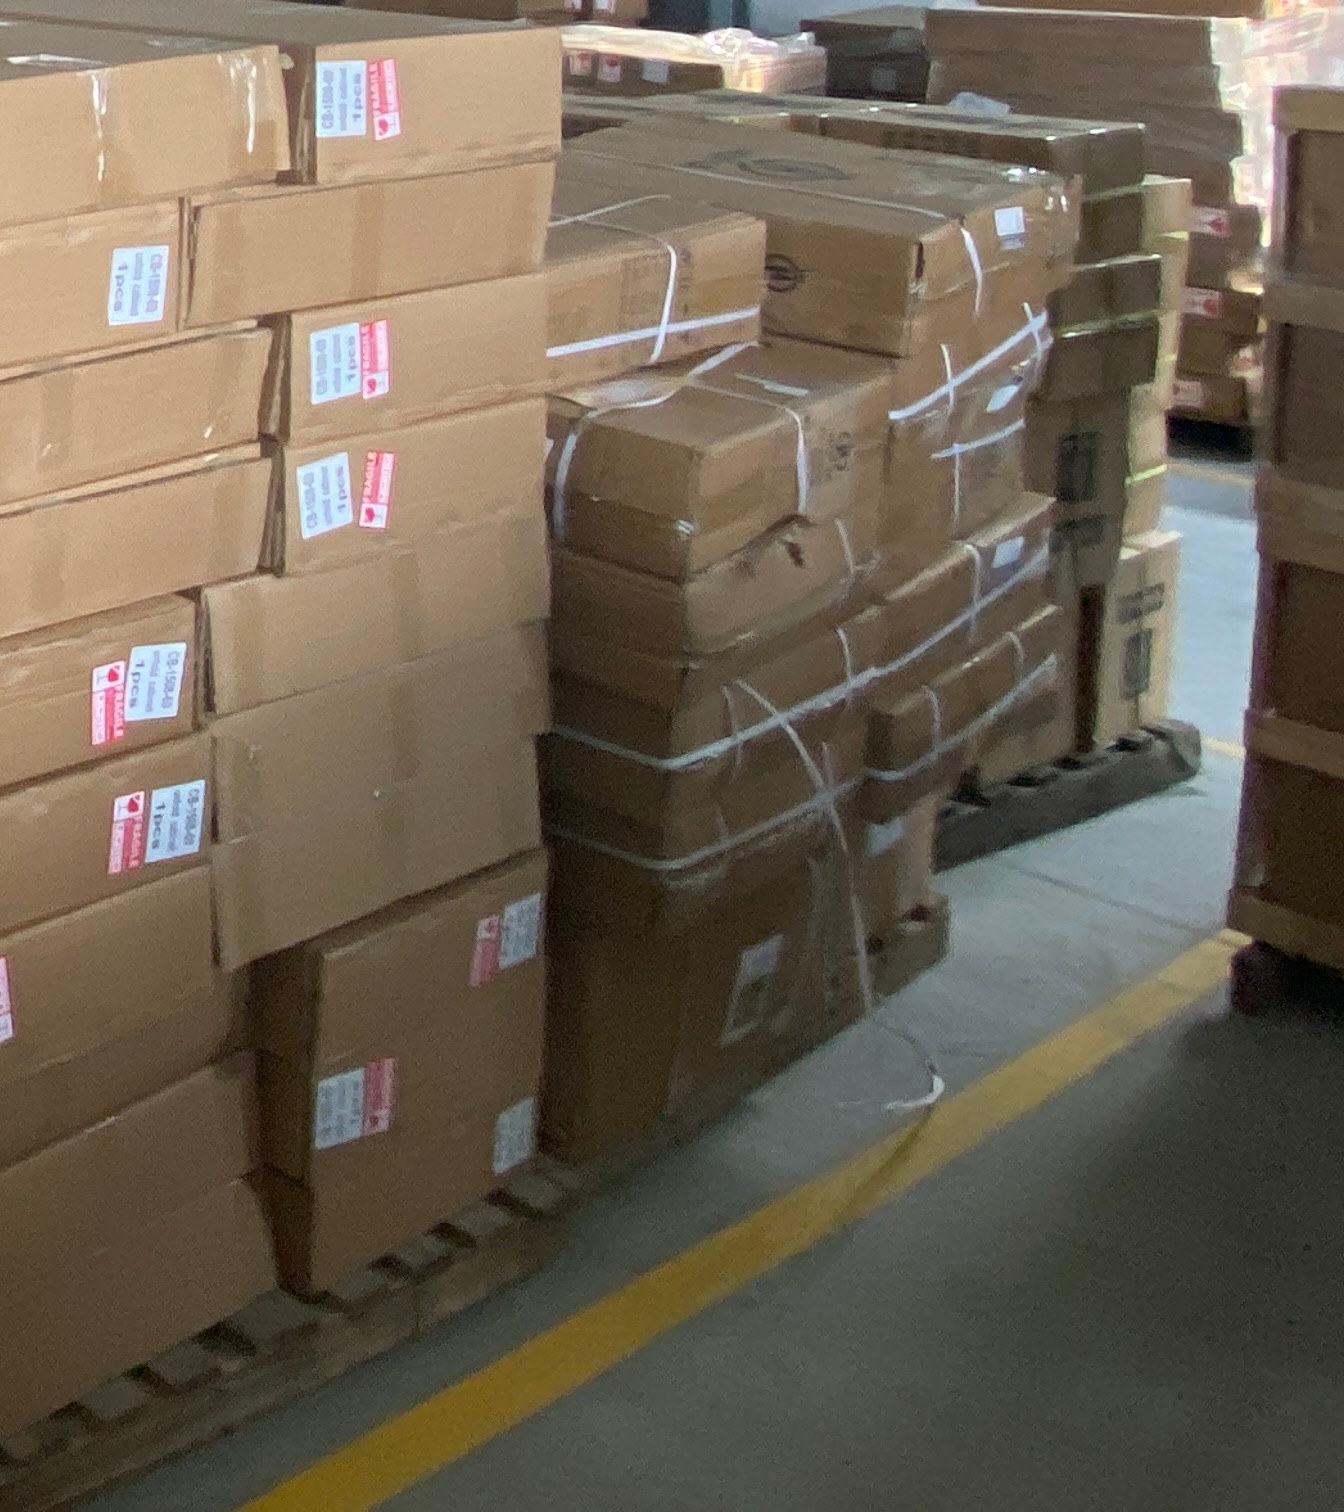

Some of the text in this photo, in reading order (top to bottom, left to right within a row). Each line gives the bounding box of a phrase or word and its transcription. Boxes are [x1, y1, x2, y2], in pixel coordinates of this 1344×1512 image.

[352, 72, 362, 122] 1pcs
[369, 62, 382, 116] FRAGILE
[113, 262, 128, 312] 1pcs
[347, 335, 357, 382] 1pcs
[361, 324, 371, 375] FRAGILE
[337, 466, 347, 513] 1pcs
[362, 451, 376, 503] FRAGILE
[129, 660, 146, 709] 1pcs
[115, 685, 125, 737] FRAGILE
[130, 817, 143, 868] FRAGILE
[151, 802, 166, 850] 1pcs
